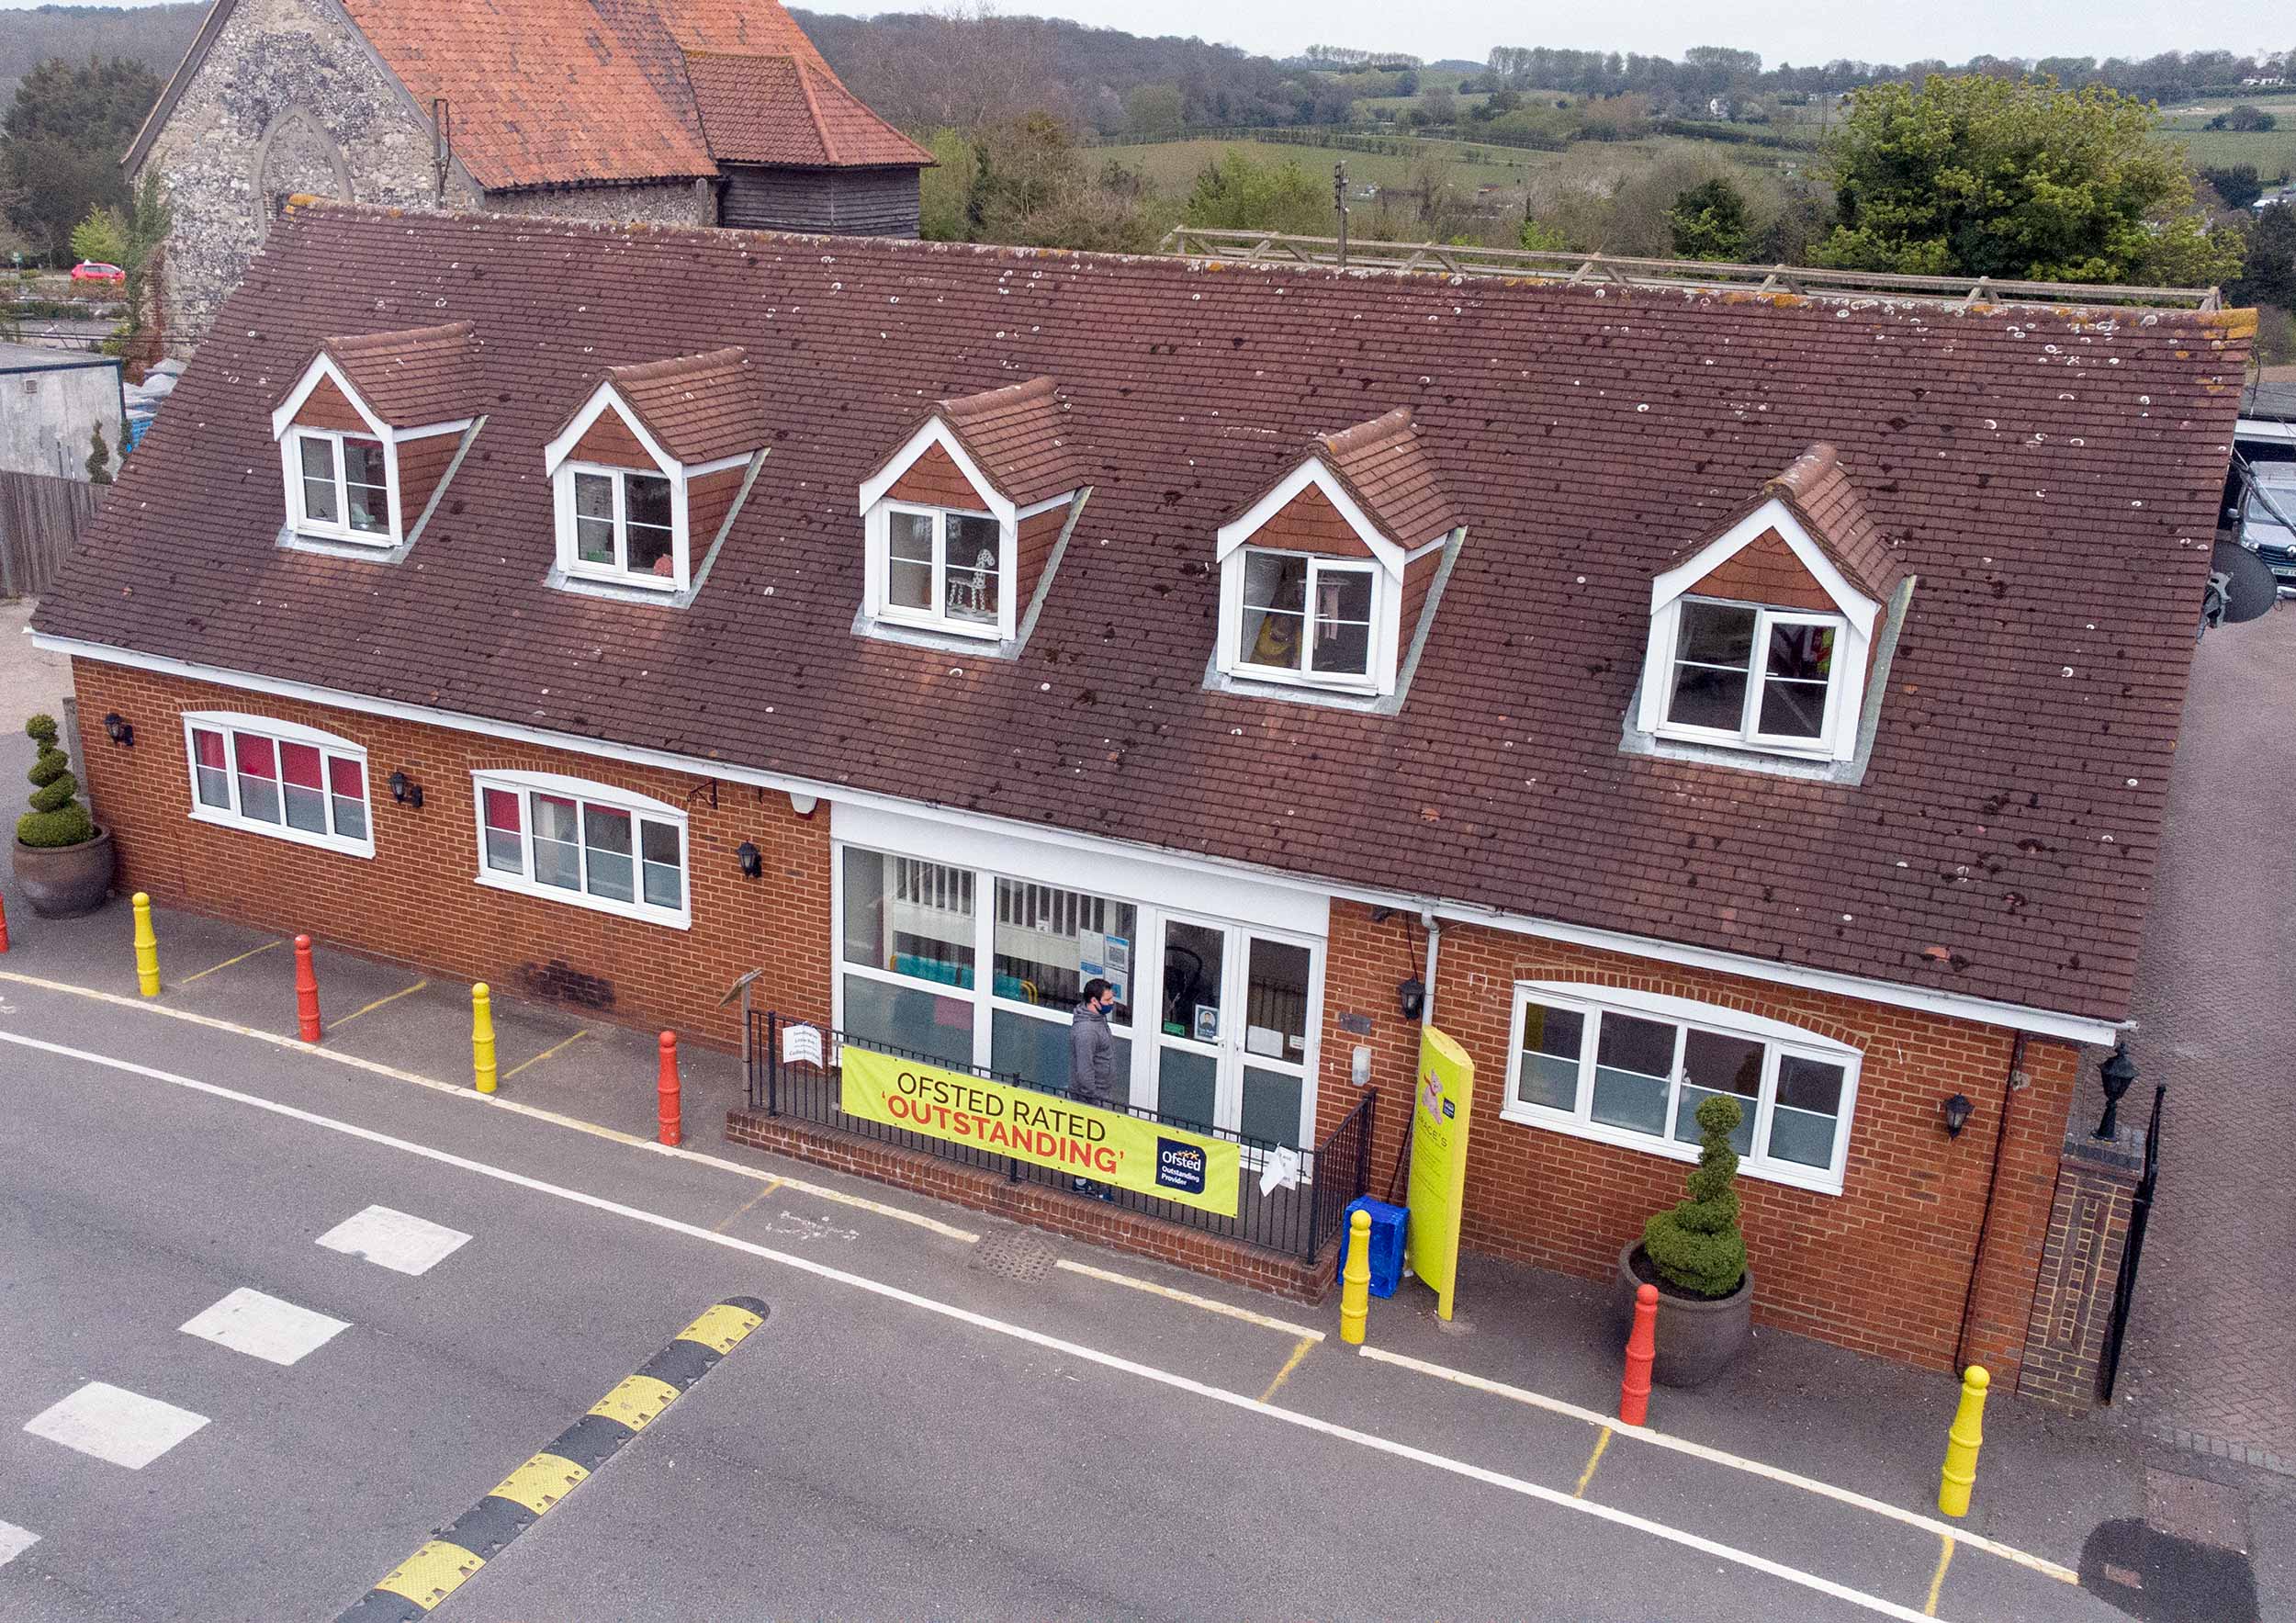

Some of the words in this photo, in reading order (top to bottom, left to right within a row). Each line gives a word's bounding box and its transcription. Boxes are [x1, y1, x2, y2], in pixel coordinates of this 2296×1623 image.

[897, 1071, 1004, 1117] OFSTED
[1013, 1099, 1106, 1142] RATED
[1162, 1150, 1201, 1171] Ofsted
[1161, 1165, 1200, 1183] Outstanding
[1161, 1173, 1187, 1185] Provider
